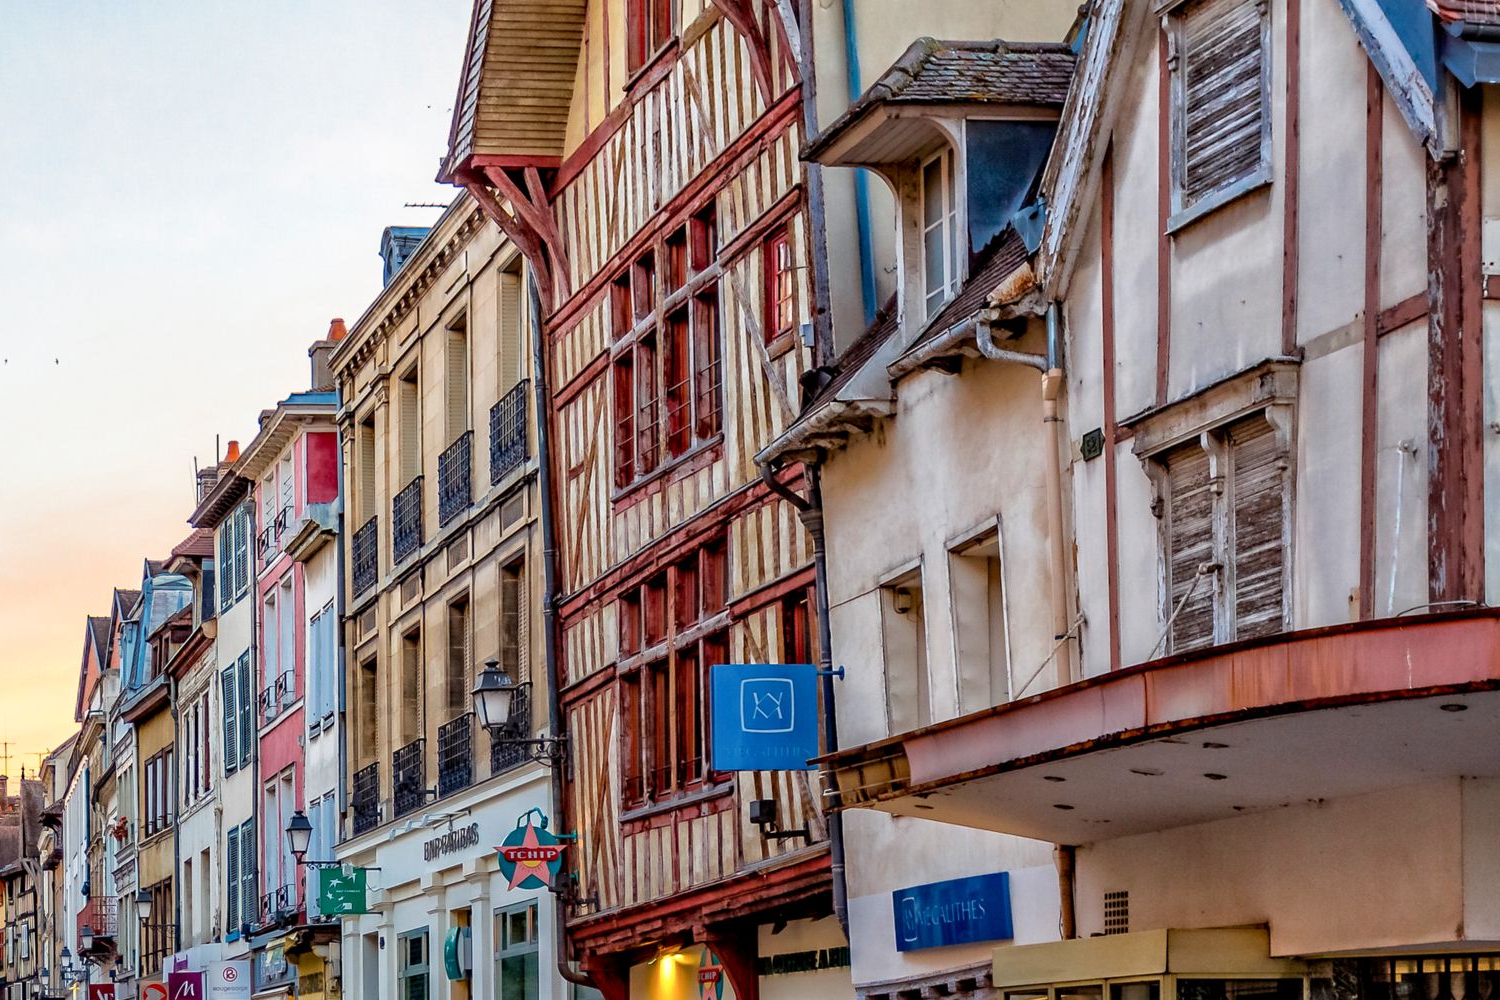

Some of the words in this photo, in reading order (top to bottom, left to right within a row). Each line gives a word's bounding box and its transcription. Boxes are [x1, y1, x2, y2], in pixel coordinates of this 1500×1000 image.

[424, 837, 442, 862] BNP
[441, 822, 480, 855] PARIBAS
[507, 850, 558, 860] TCHIP
